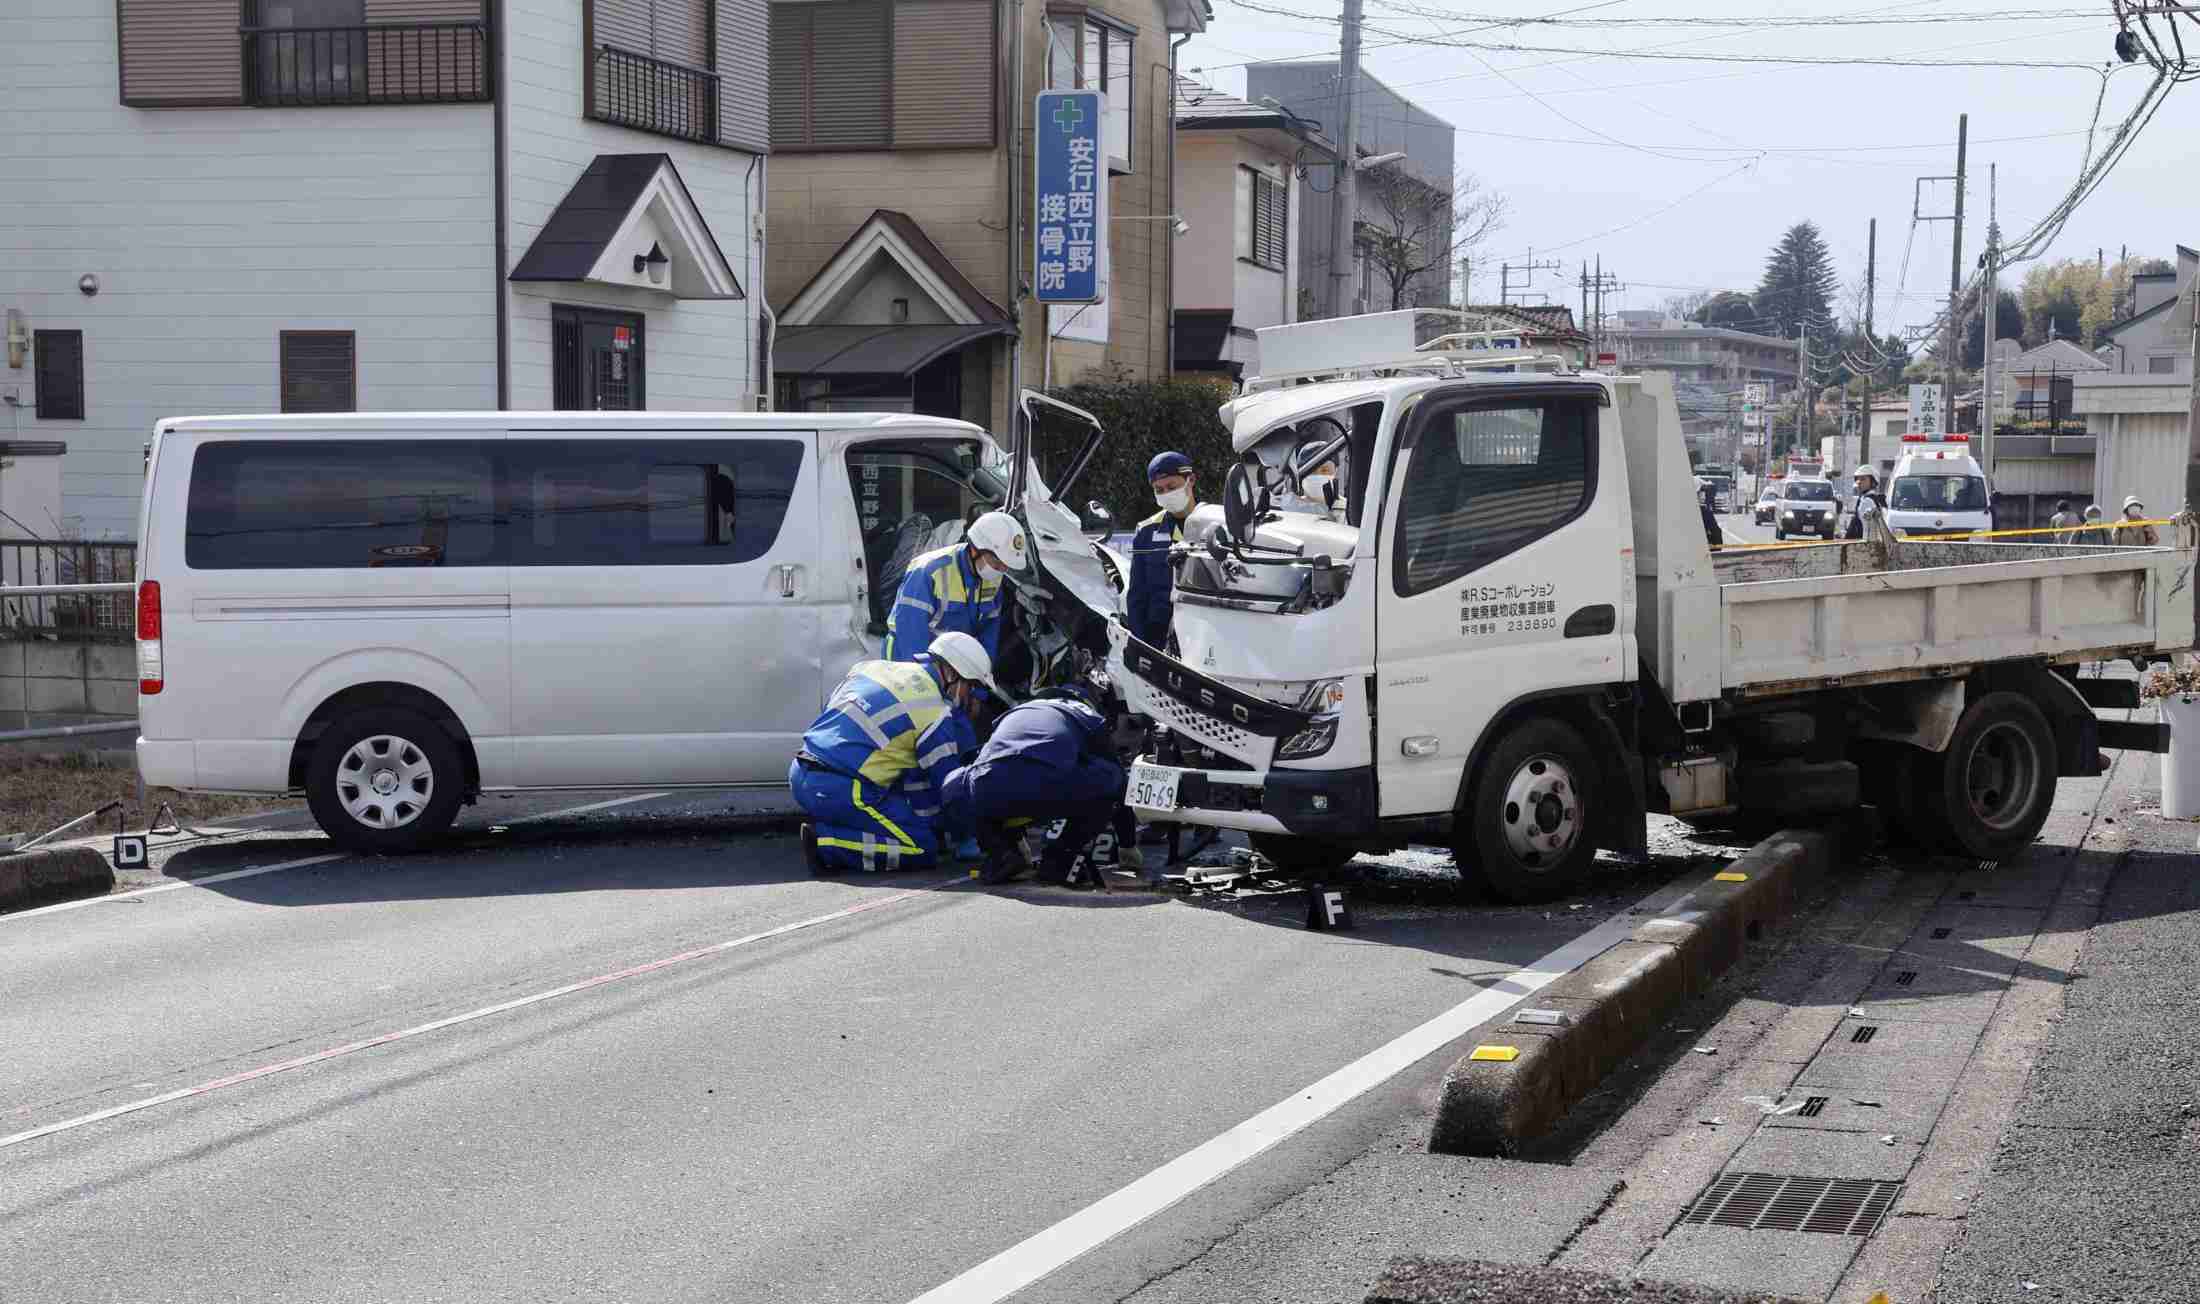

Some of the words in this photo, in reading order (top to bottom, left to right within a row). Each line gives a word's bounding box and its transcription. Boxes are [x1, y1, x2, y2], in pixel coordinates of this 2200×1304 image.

[1068, 137, 1095, 273] 安行西立野
[1040, 193, 1066, 290] 接骨院
[1920, 387, 1937, 432] 小品盆
[1507, 618, 1556, 631] 233890
[1139, 656, 1249, 723] FUSO
[1046, 818, 1067, 839] 3
[118, 838, 144, 864] D
[1092, 833, 1114, 861] 2
[1323, 891, 1344, 925] F
